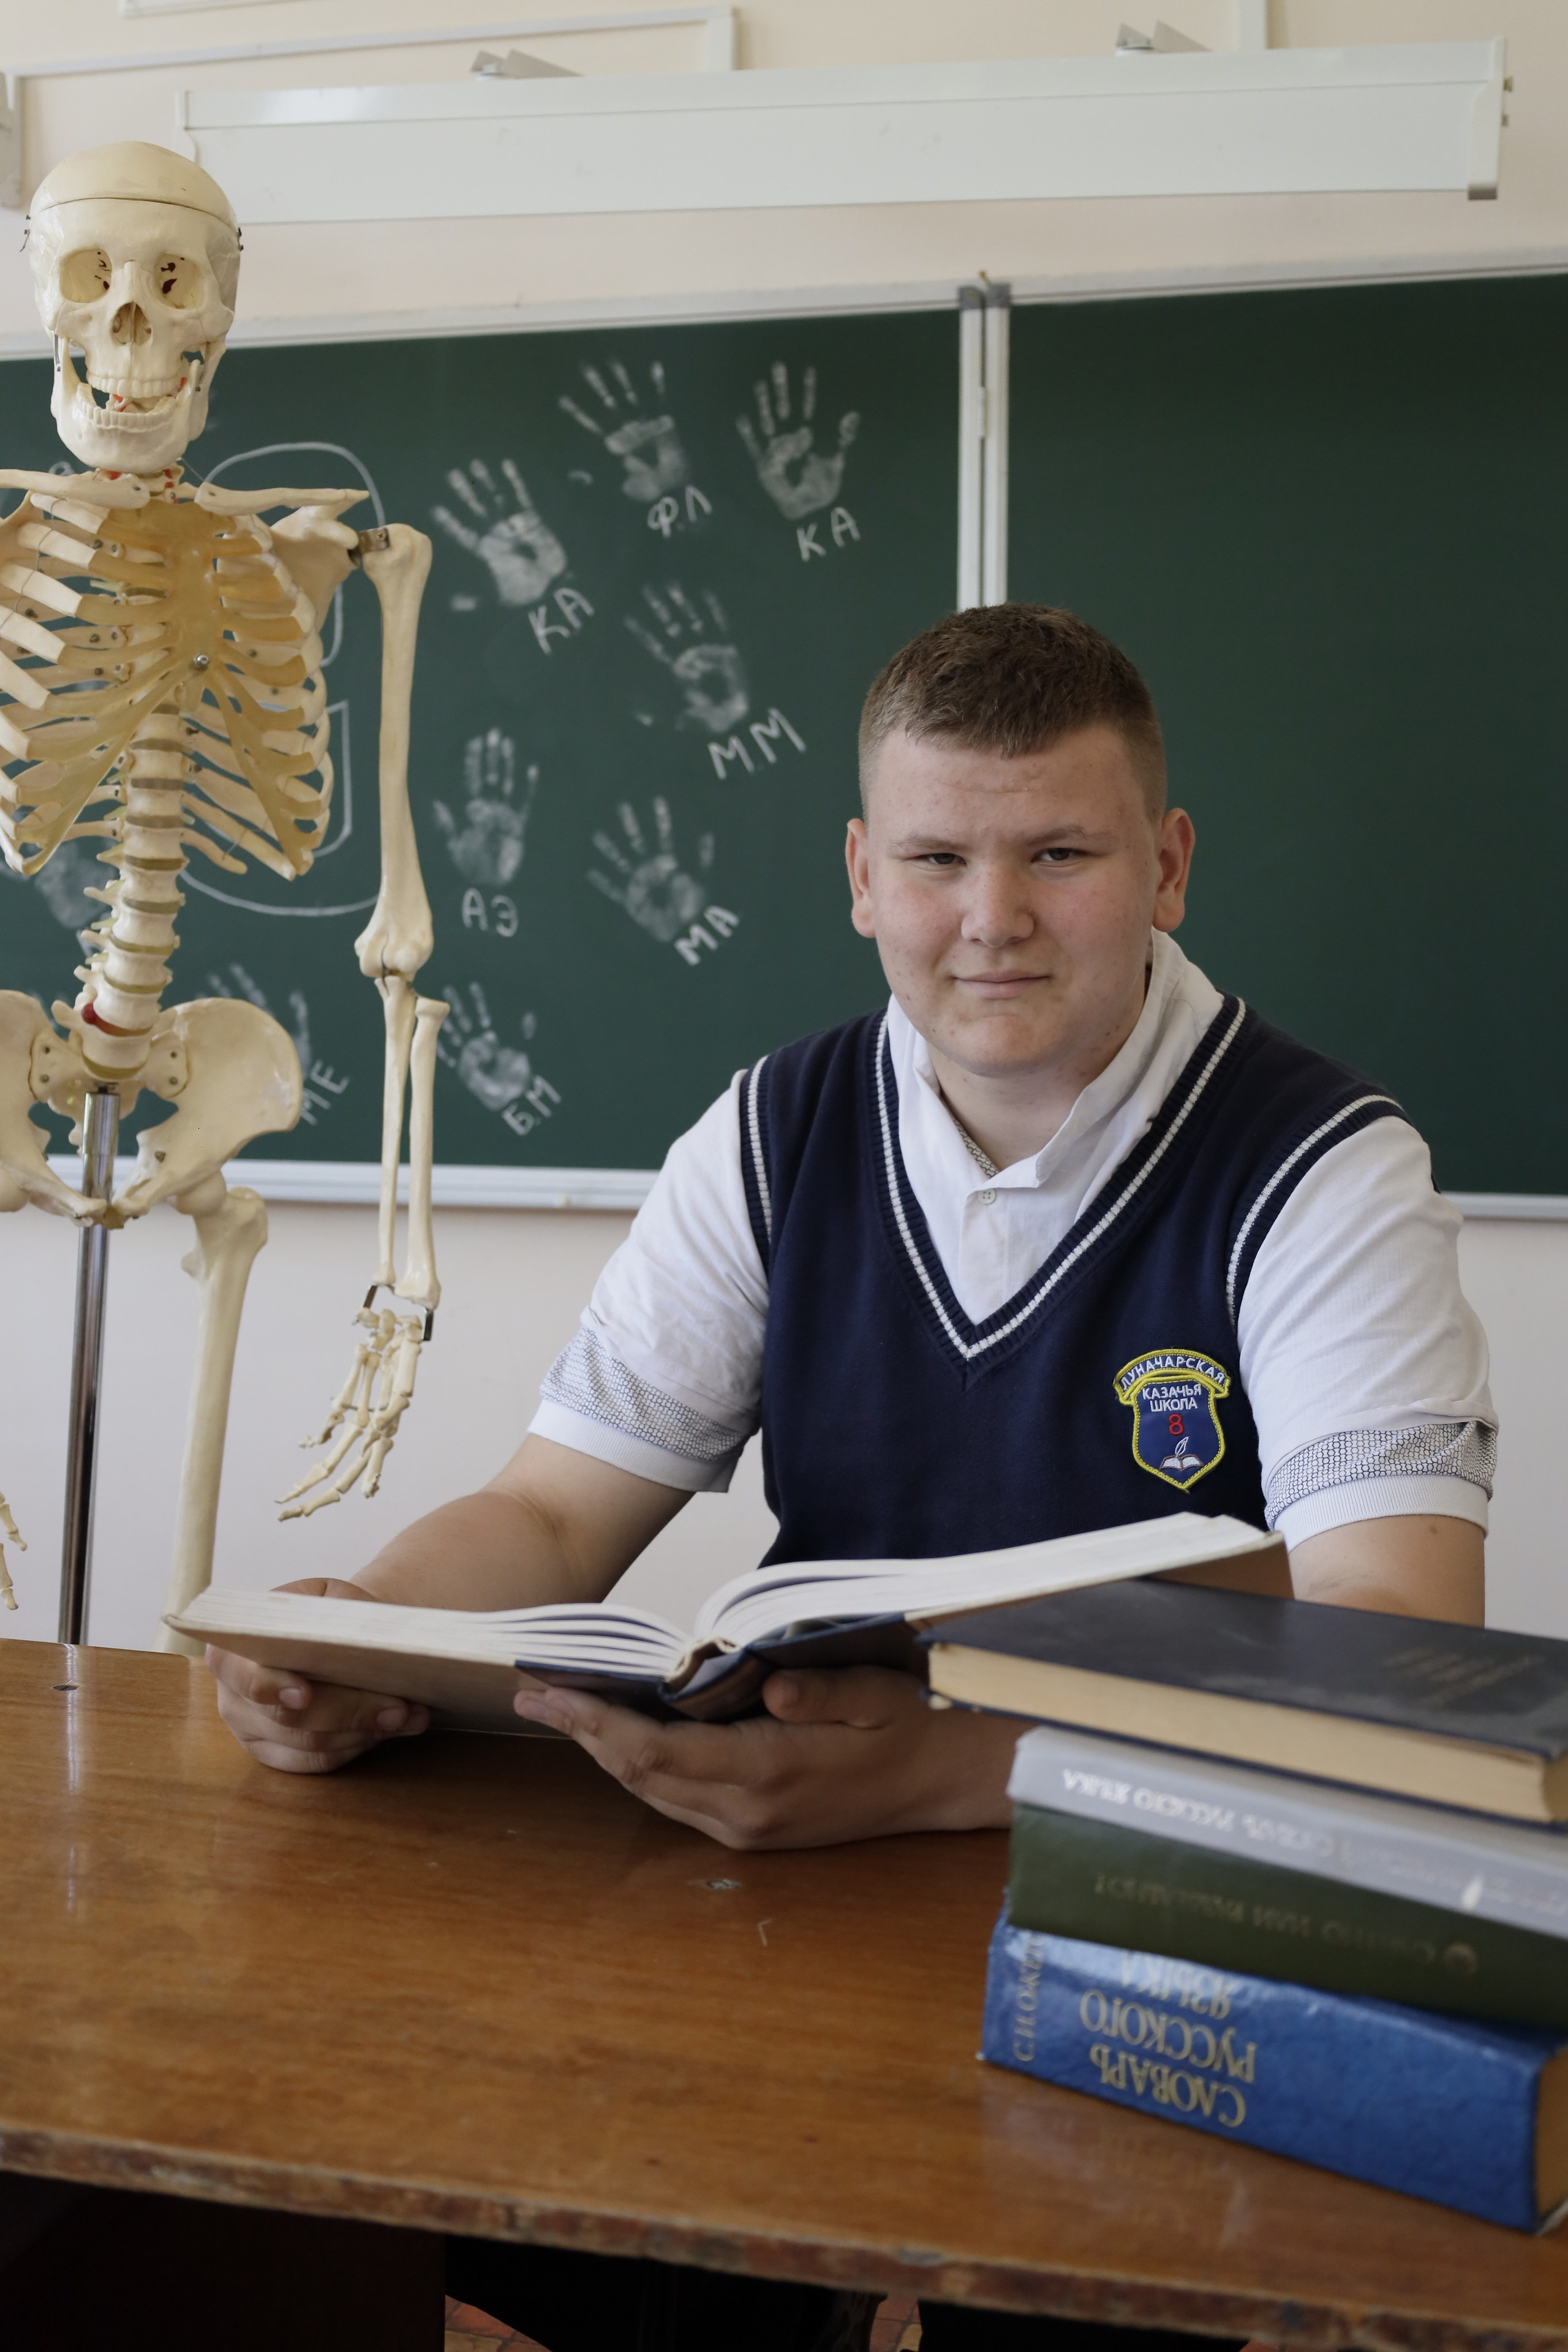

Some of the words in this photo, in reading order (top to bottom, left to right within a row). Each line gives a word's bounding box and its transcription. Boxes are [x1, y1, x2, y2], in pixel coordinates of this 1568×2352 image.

[797, 507, 860, 561] КА
[528, 587, 594, 654] КА
[707, 707, 806, 780] ММ
[676, 905, 739, 966] МА
[1120, 1355, 1224, 1390] ЛУНАЧАРСКАЯ
[1142, 1384, 1202, 1400] КАЗАЧЬЯ
[1150, 1398, 1198, 1412] ШКОЛА
[1169, 1413, 1184, 1436] 8
[1079, 1988, 1256, 2083] РУССКОГО
[1090, 2043, 1246, 2128] СЛОВАРЬ
